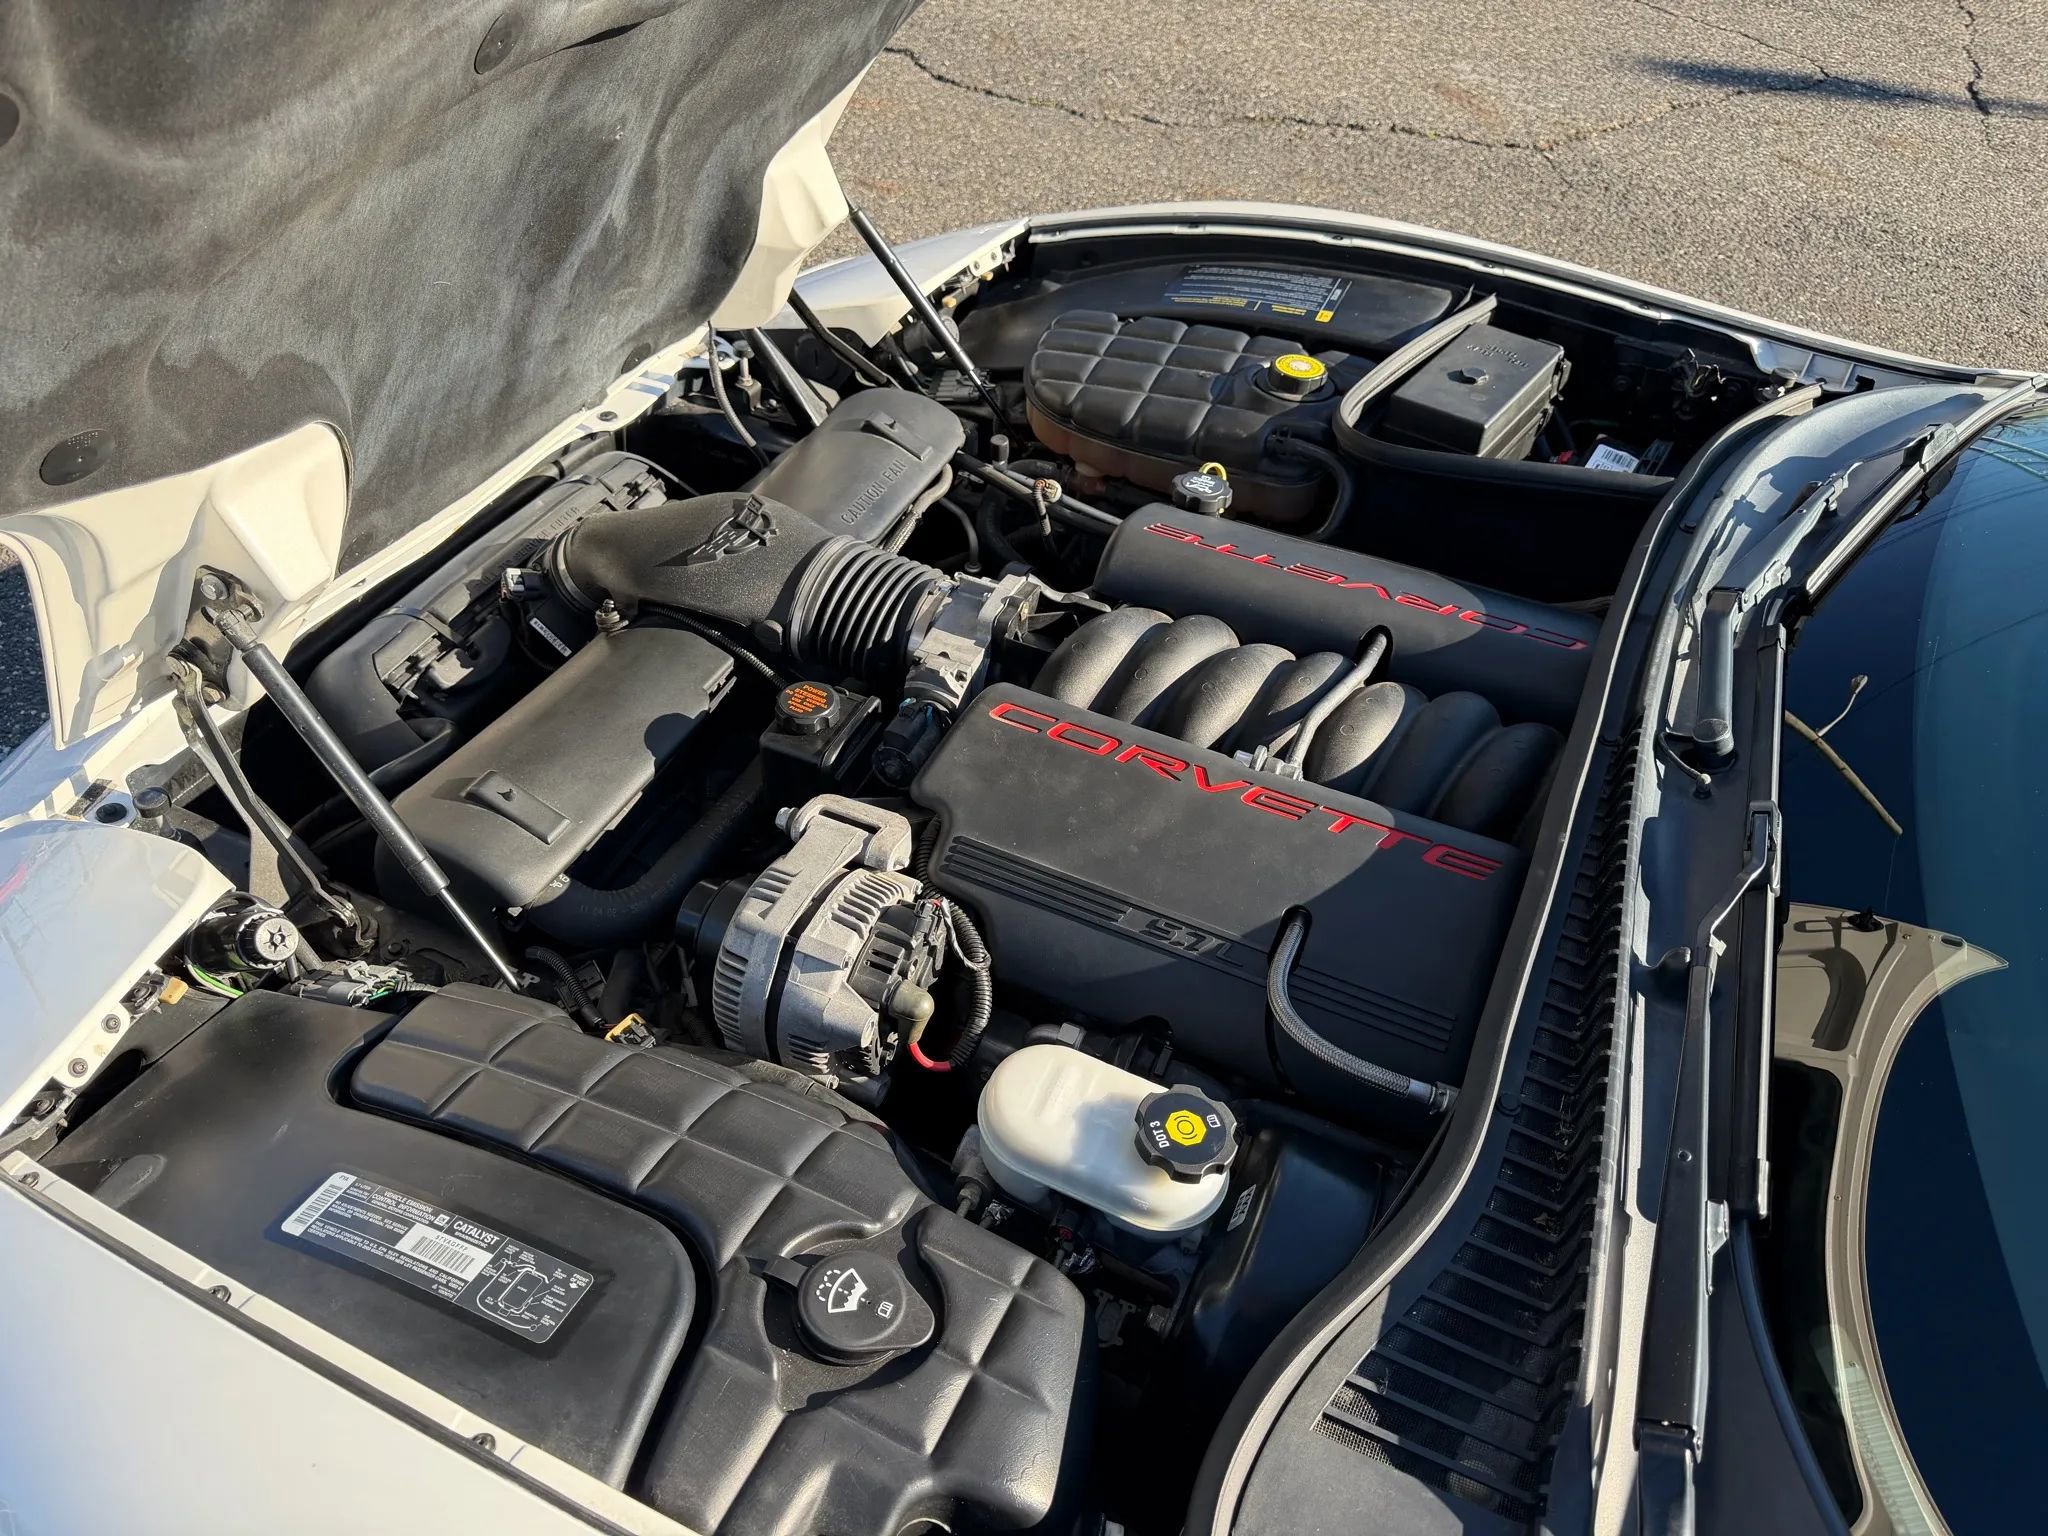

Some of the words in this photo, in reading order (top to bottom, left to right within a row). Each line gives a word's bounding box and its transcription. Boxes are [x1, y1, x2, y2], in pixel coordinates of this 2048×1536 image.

[840, 480, 886, 524] CAUTION
[882, 458, 908, 482] FAN
[1144, 522, 1589, 650] CORVETTE
[794, 688, 826, 704] STEERING
[802, 684, 828, 697] POWER
[988, 702, 1503, 881] CORVETTE
[1150, 1120, 1160, 1128] 3
[1152, 1130, 1170, 1148] DOT
[372, 1193, 397, 1206] CONTROL
[398, 1203, 435, 1220] INFORMATION
[384, 1191, 407, 1202] VEHICLE
[406, 1199, 432, 1212] EMISSION
[453, 1220, 500, 1246] CATALYST
[572, 1273, 589, 1282] FRONT
